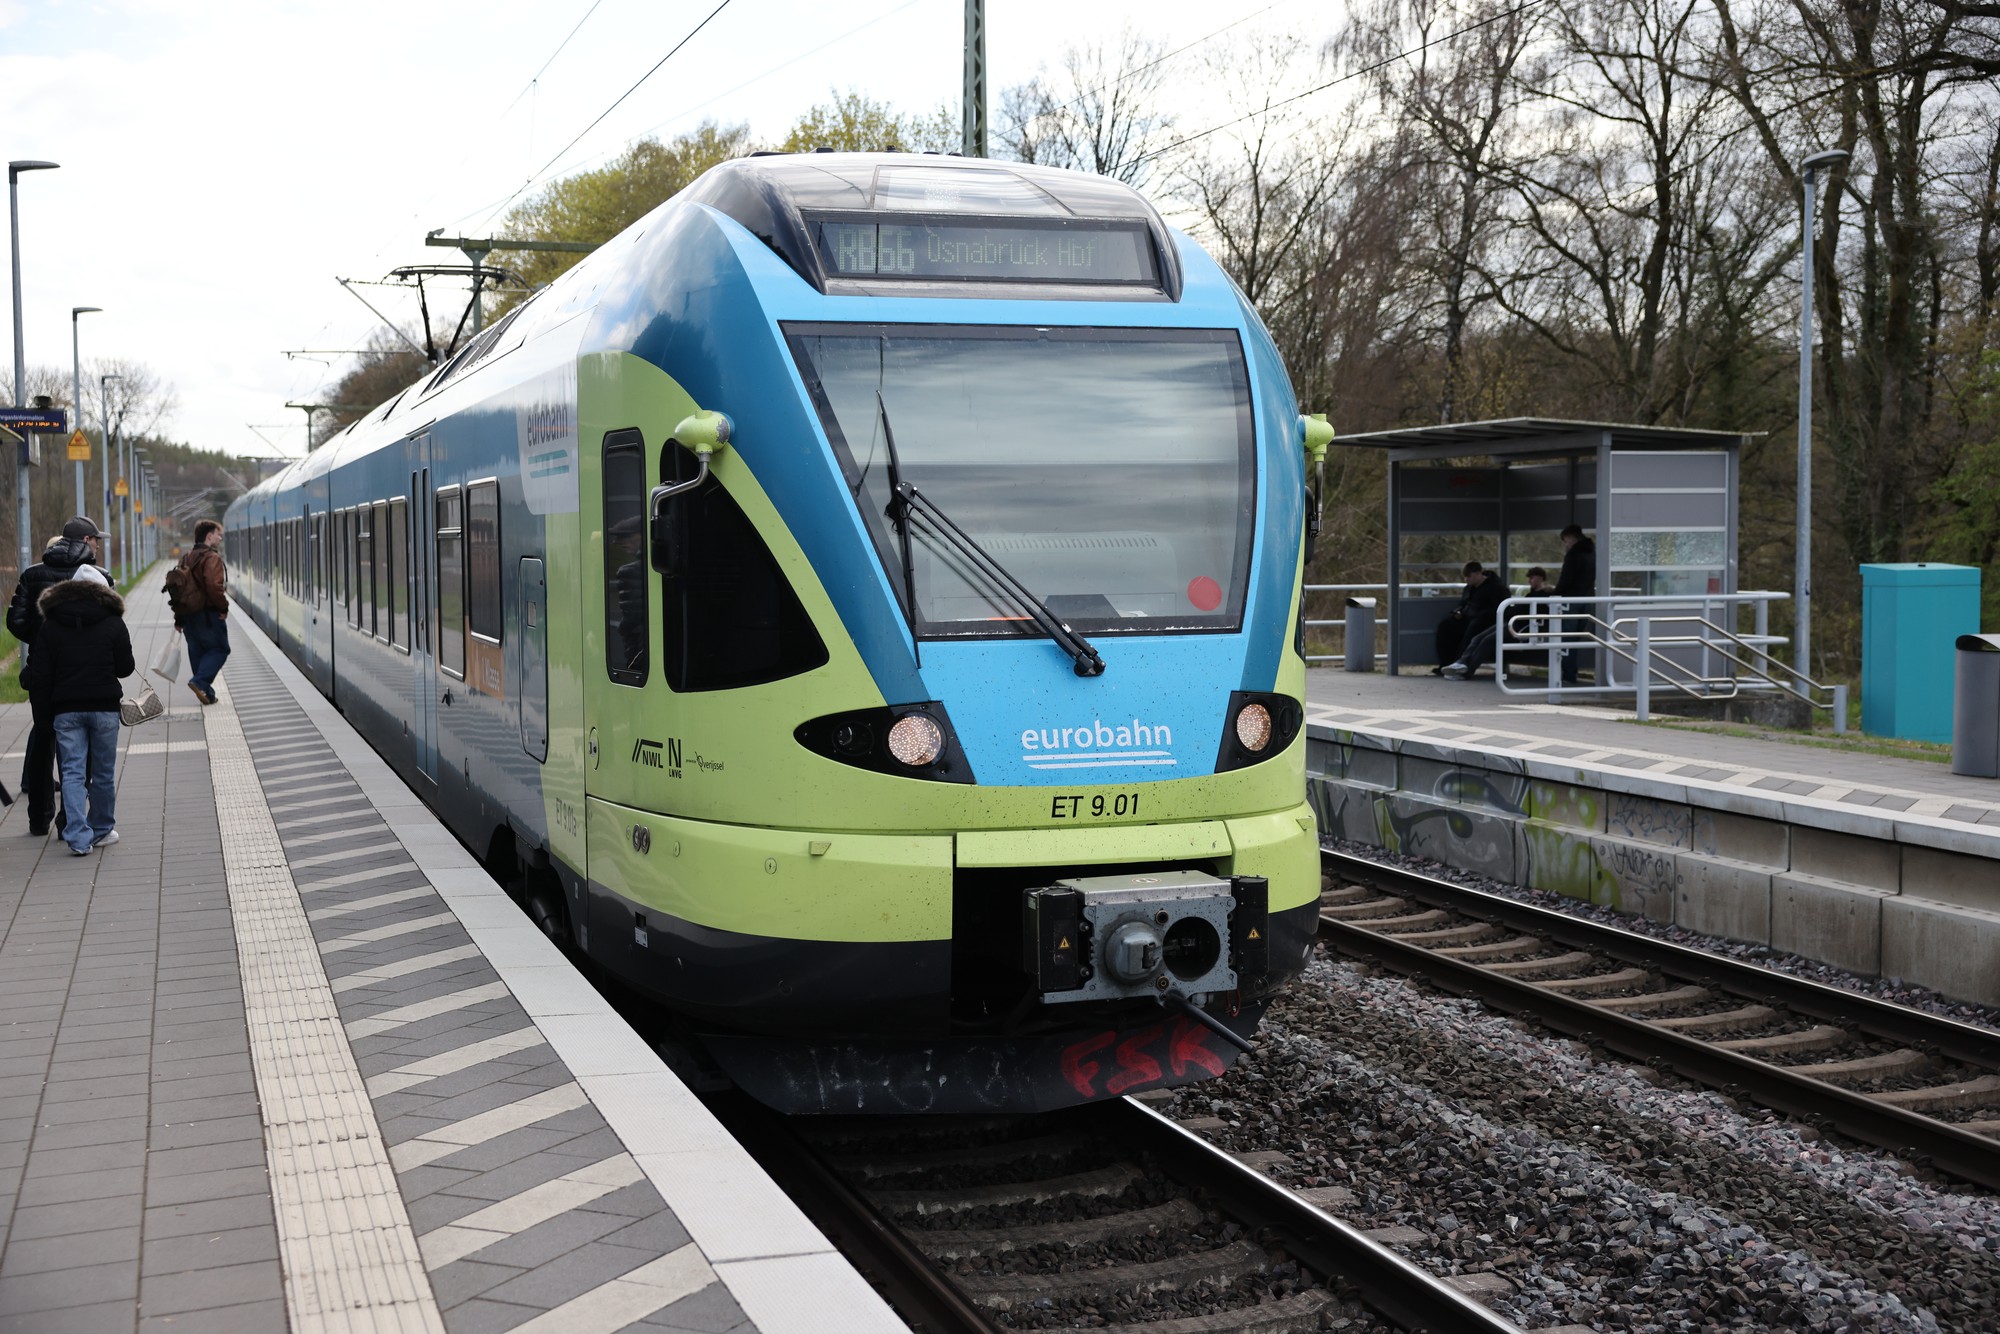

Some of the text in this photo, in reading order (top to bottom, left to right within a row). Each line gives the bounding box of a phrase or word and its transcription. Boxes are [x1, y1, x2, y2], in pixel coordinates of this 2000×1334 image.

[839, 229, 1096, 272] RB66 Osnabrück Hbf
[527, 402, 569, 447] eurobahn
[1021, 718, 1172, 750] eurobahn
[642, 749, 664, 769] NWL
[1051, 793, 1139, 819] ET 9.01
[1060, 1017, 1225, 1098] FSK
